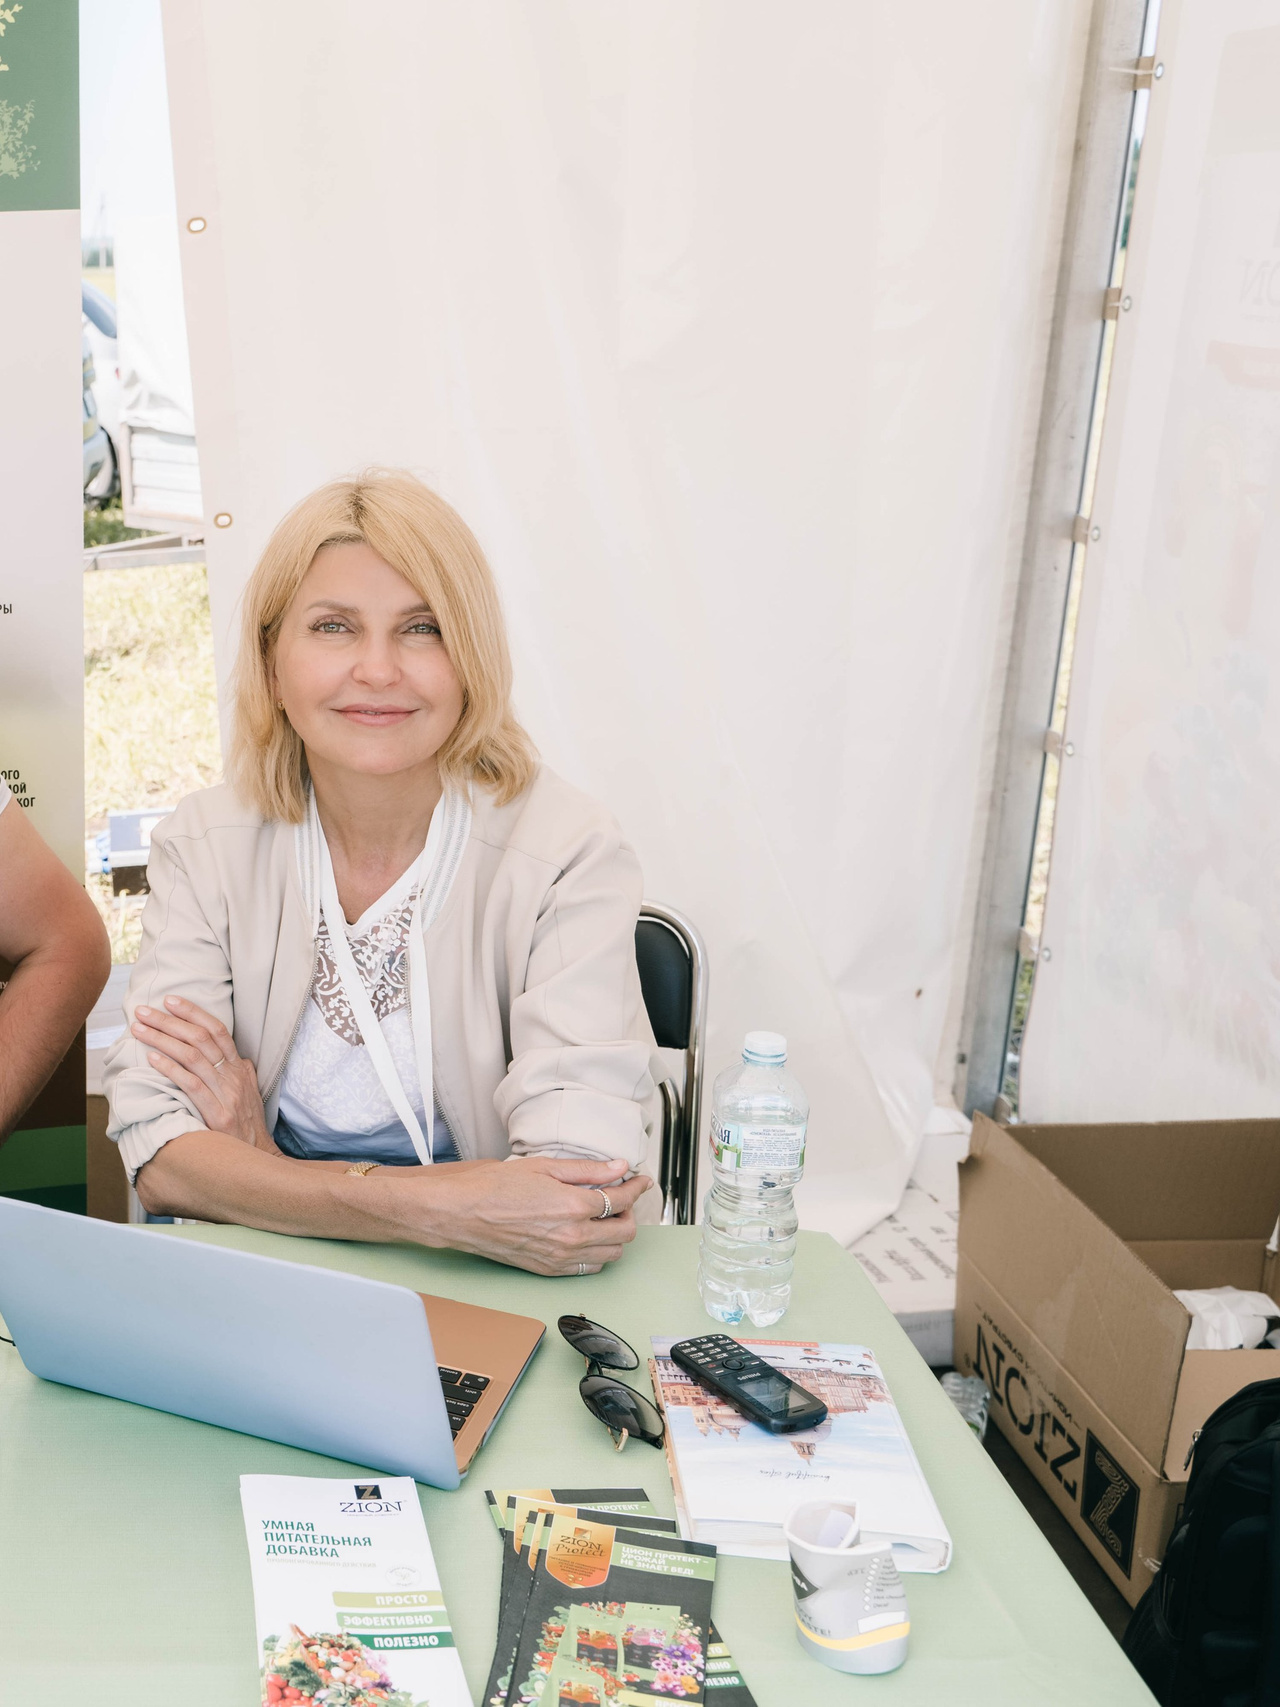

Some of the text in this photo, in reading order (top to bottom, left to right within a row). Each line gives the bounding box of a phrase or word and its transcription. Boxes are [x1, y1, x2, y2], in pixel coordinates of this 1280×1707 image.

[971, 1323, 1082, 1503] ZION
[339, 1500, 403, 1513] ZION
[261, 1519, 315, 1532] УМНАЯ
[264, 1531, 373, 1547] ПИТАТЕЛЬНАЯ
[560, 1535, 603, 1551] ZION
[266, 1544, 340, 1558] ДОБАВКА
[622, 1546, 653, 1558] ЦИОН
[654, 1551, 702, 1564] ПРОТЕКТ
[620, 1558, 634, 1567] НЕ
[621, 1552, 666, 1566] УРОЖАЙ
[375, 1594, 428, 1606] ПРОСТО
[343, 1614, 434, 1627] ЭФФЕКТИВНО
[373, 1634, 439, 1649] ПОЛЕЗНО
